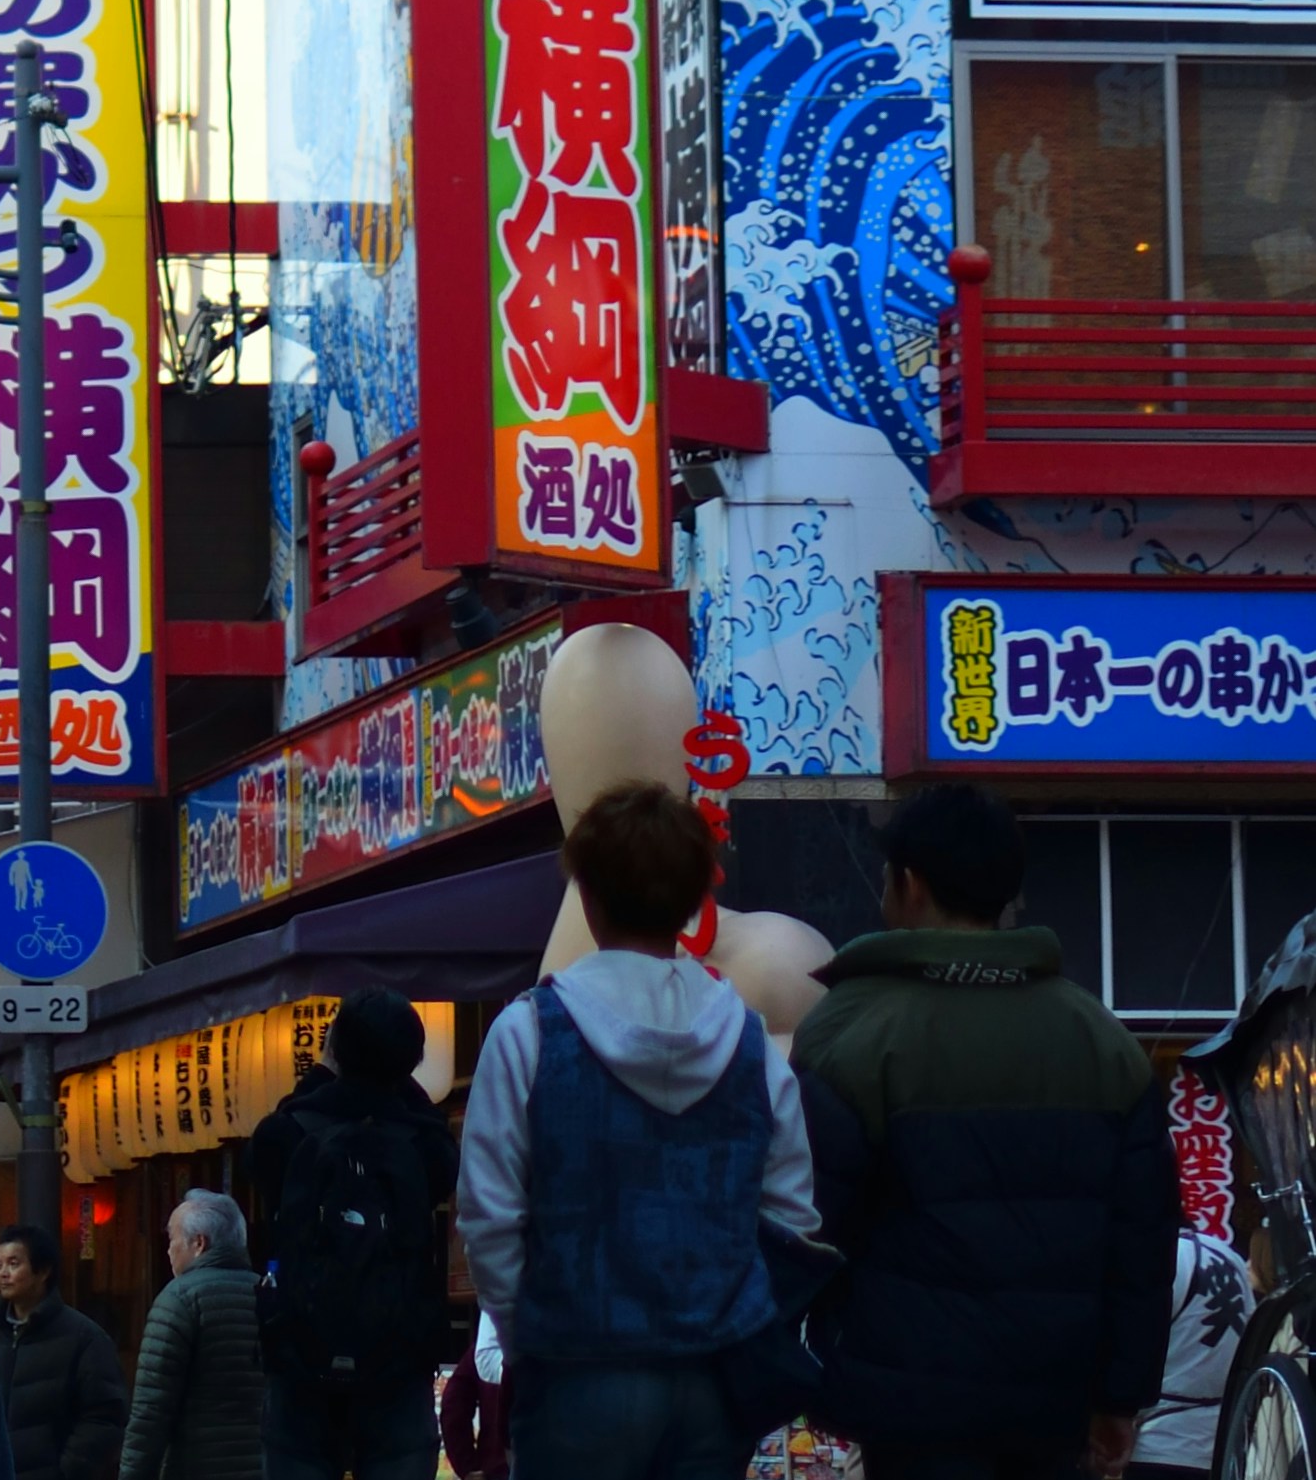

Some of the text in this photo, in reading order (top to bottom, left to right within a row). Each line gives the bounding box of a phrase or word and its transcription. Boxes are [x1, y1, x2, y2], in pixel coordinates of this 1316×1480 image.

[519, 443, 640, 548] 酒処
[948, 604, 997, 746] 新世界
[1006, 633, 1316, 720] 日本一の串か
